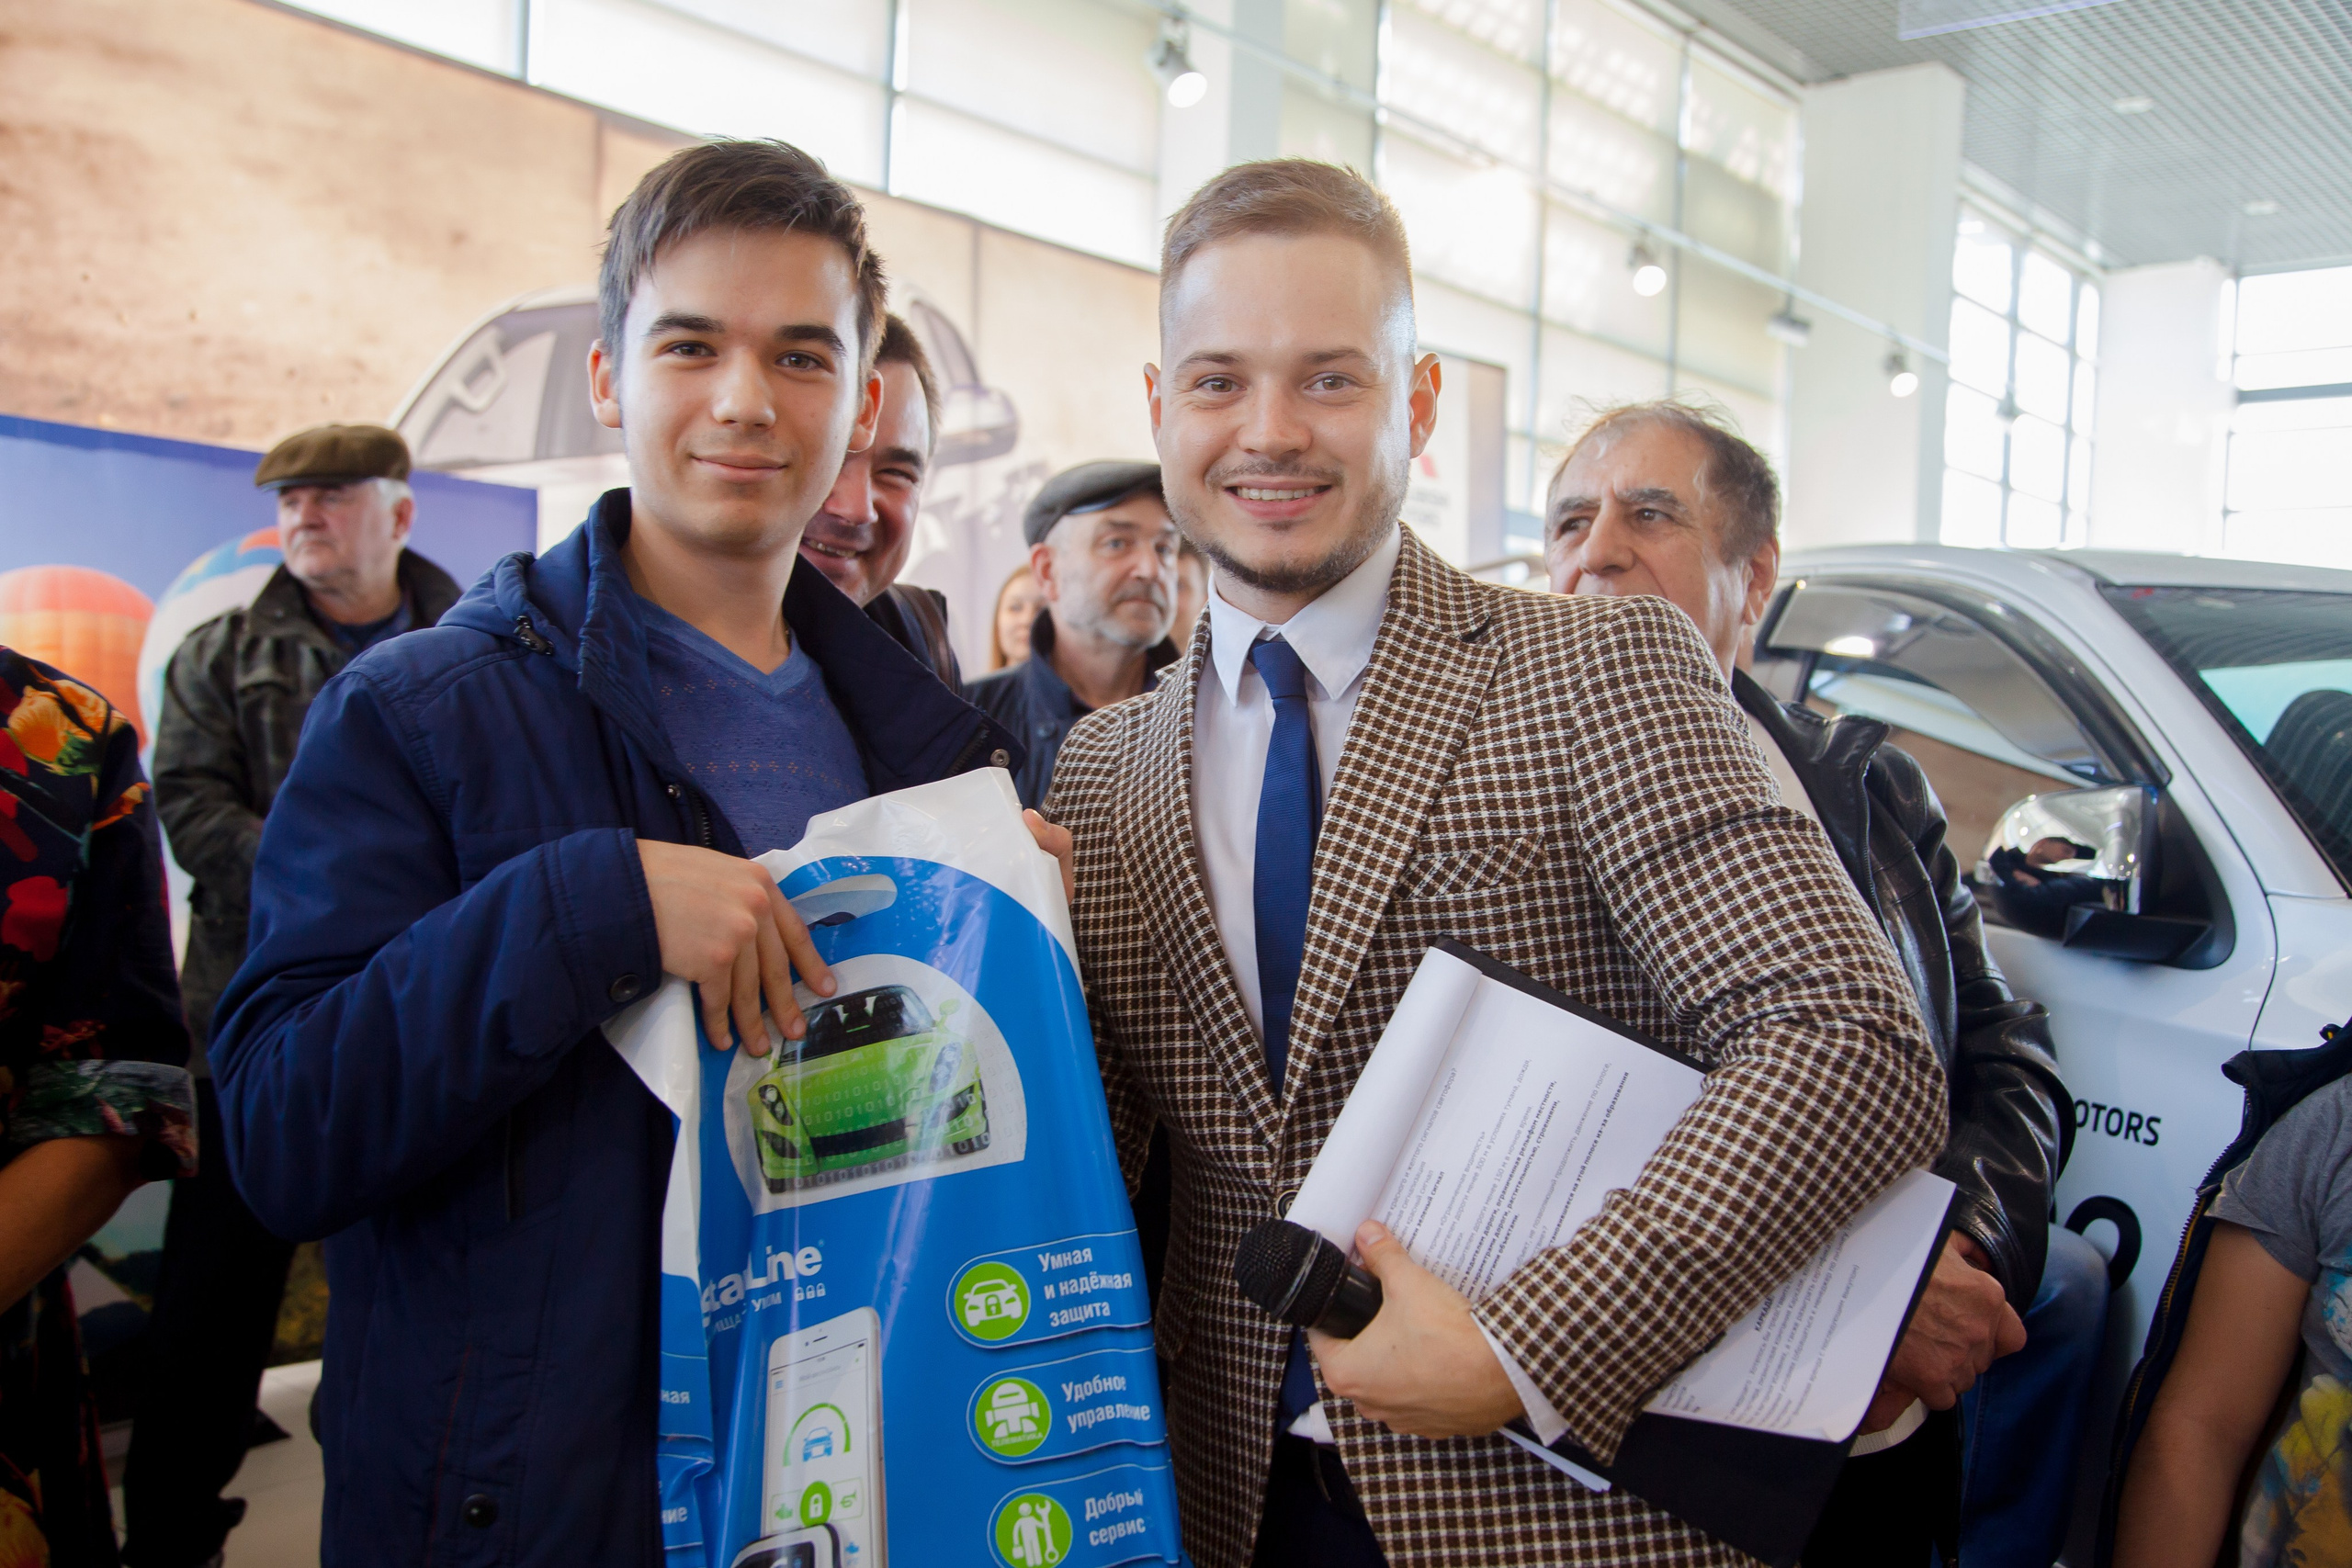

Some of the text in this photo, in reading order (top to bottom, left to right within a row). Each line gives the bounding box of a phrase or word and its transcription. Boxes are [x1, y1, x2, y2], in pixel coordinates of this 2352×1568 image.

[1420, 1109, 1439, 1142] сигналов
[2075, 1098, 2162, 1147] OTORS
[1464, 1235, 1486, 1275] водителем
[1483, 1206, 1499, 1235] дороги,
[1496, 1156, 1522, 1207] ограниченная
[1518, 1119, 1539, 1156] рельефом
[1534, 1078, 1555, 1119] местности,
[1493, 1208, 1510, 1238] дороги,
[1507, 1144, 1540, 1209] растительностью,
[1535, 1098, 1560, 1144] строениями,
[1546, 1071, 1630, 1247] становившееся на этой полосе из-за образования
[1415, 1195, 1433, 1226] зеленый
[1430, 1170, 1444, 1195] сигнал
[1037, 1247, 1093, 1273] Умная
[1044, 1283, 1056, 1300] и
[1049, 1301, 1112, 1327] защита
[1089, 1517, 1147, 1547] сервис
